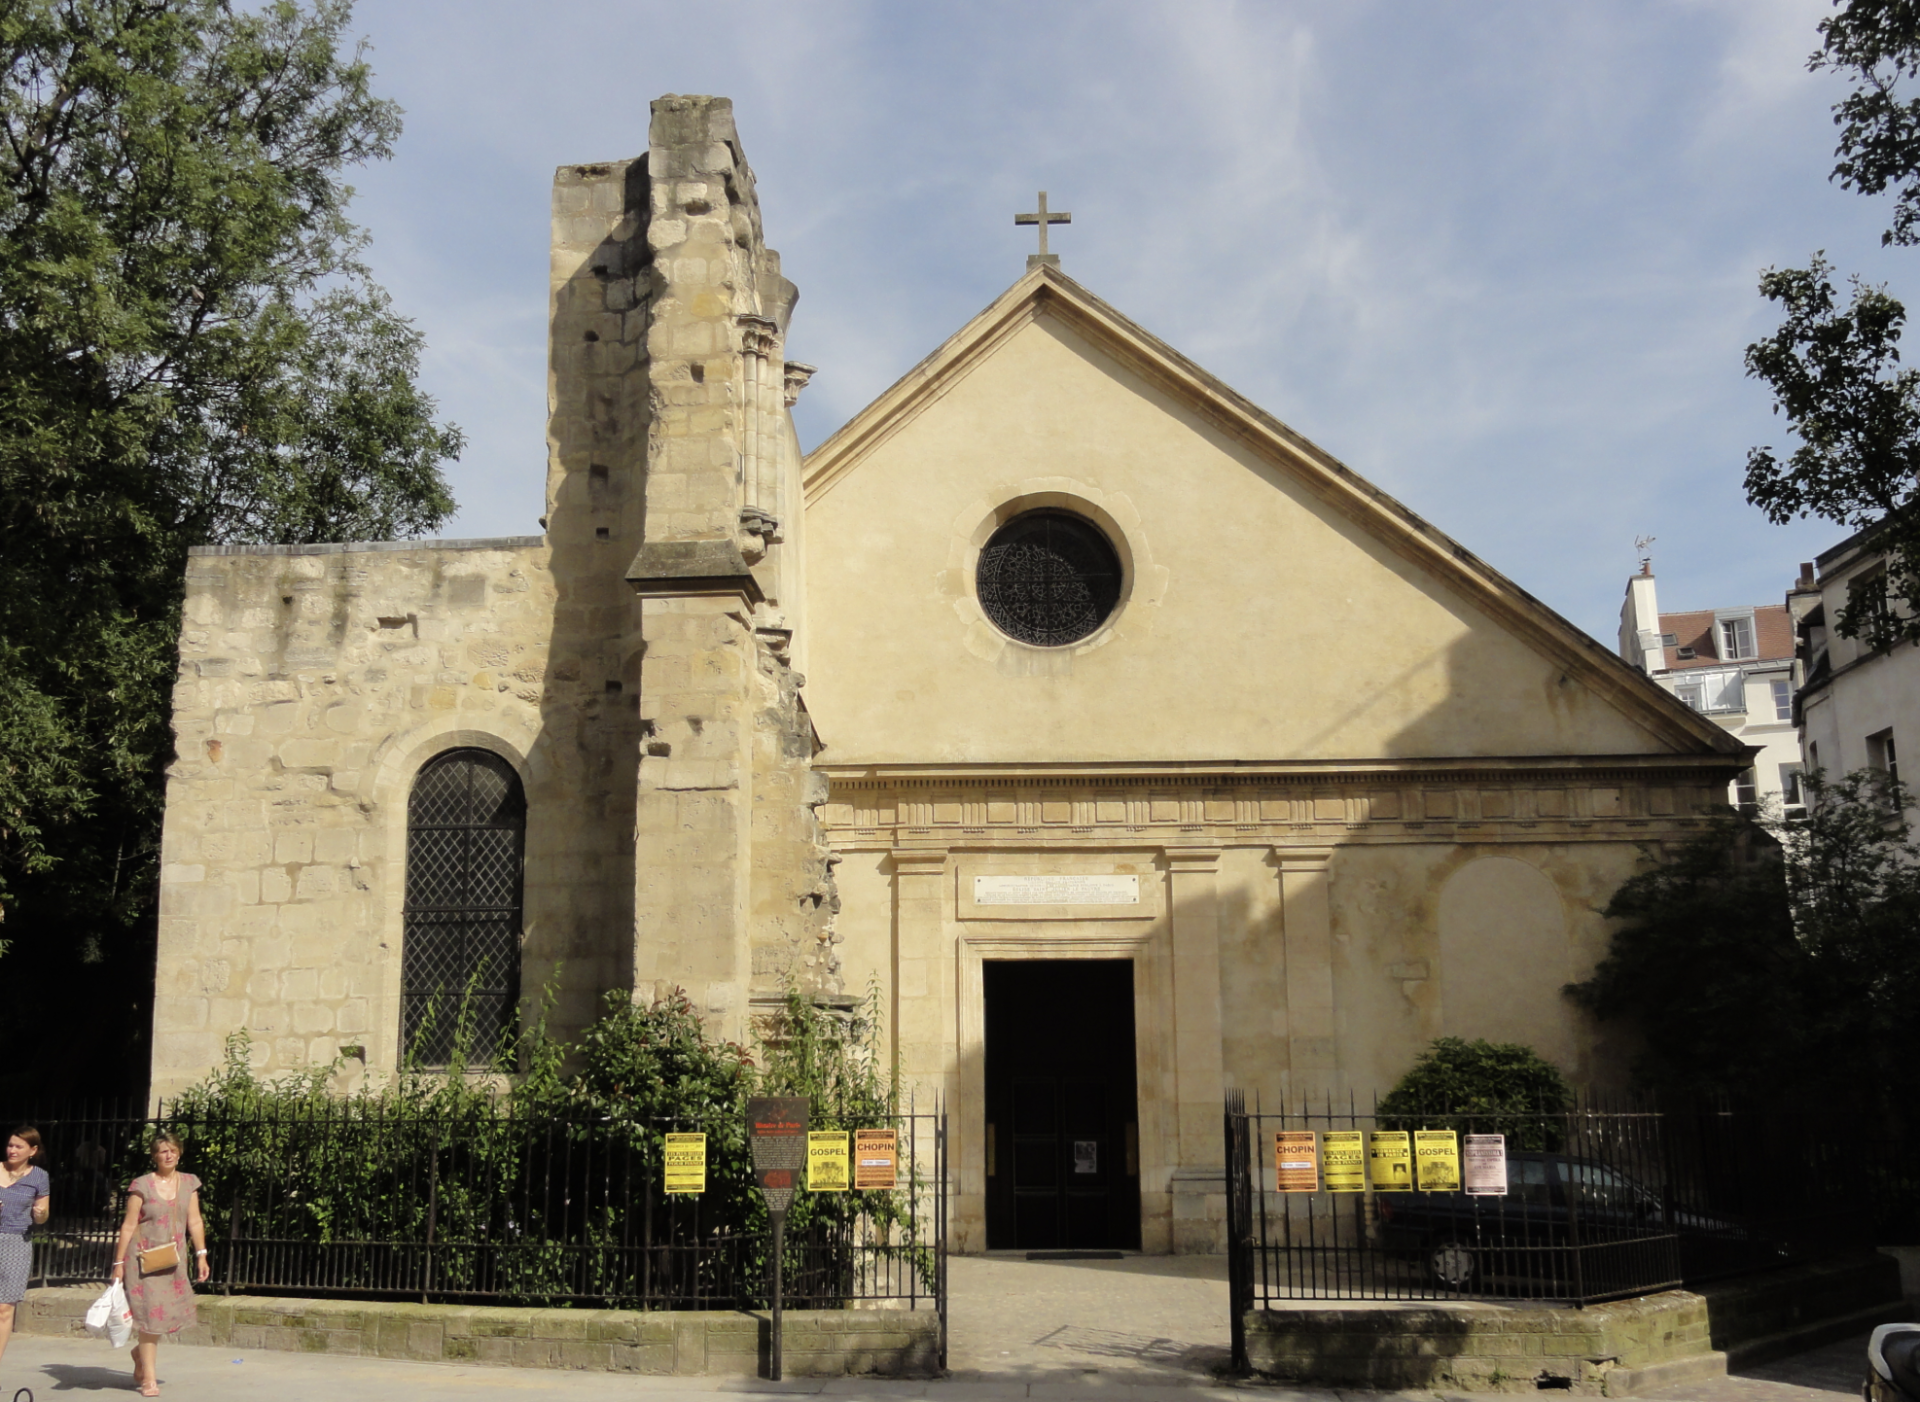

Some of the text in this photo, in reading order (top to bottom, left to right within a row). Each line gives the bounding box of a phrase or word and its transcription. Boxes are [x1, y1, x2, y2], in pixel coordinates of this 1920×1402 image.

[857, 1143, 895, 1151] CHOPIN
[1276, 1145, 1315, 1154] CHOPIN
[810, 1148, 847, 1156] GOSPEL
[1418, 1148, 1456, 1156] GOSPEL
